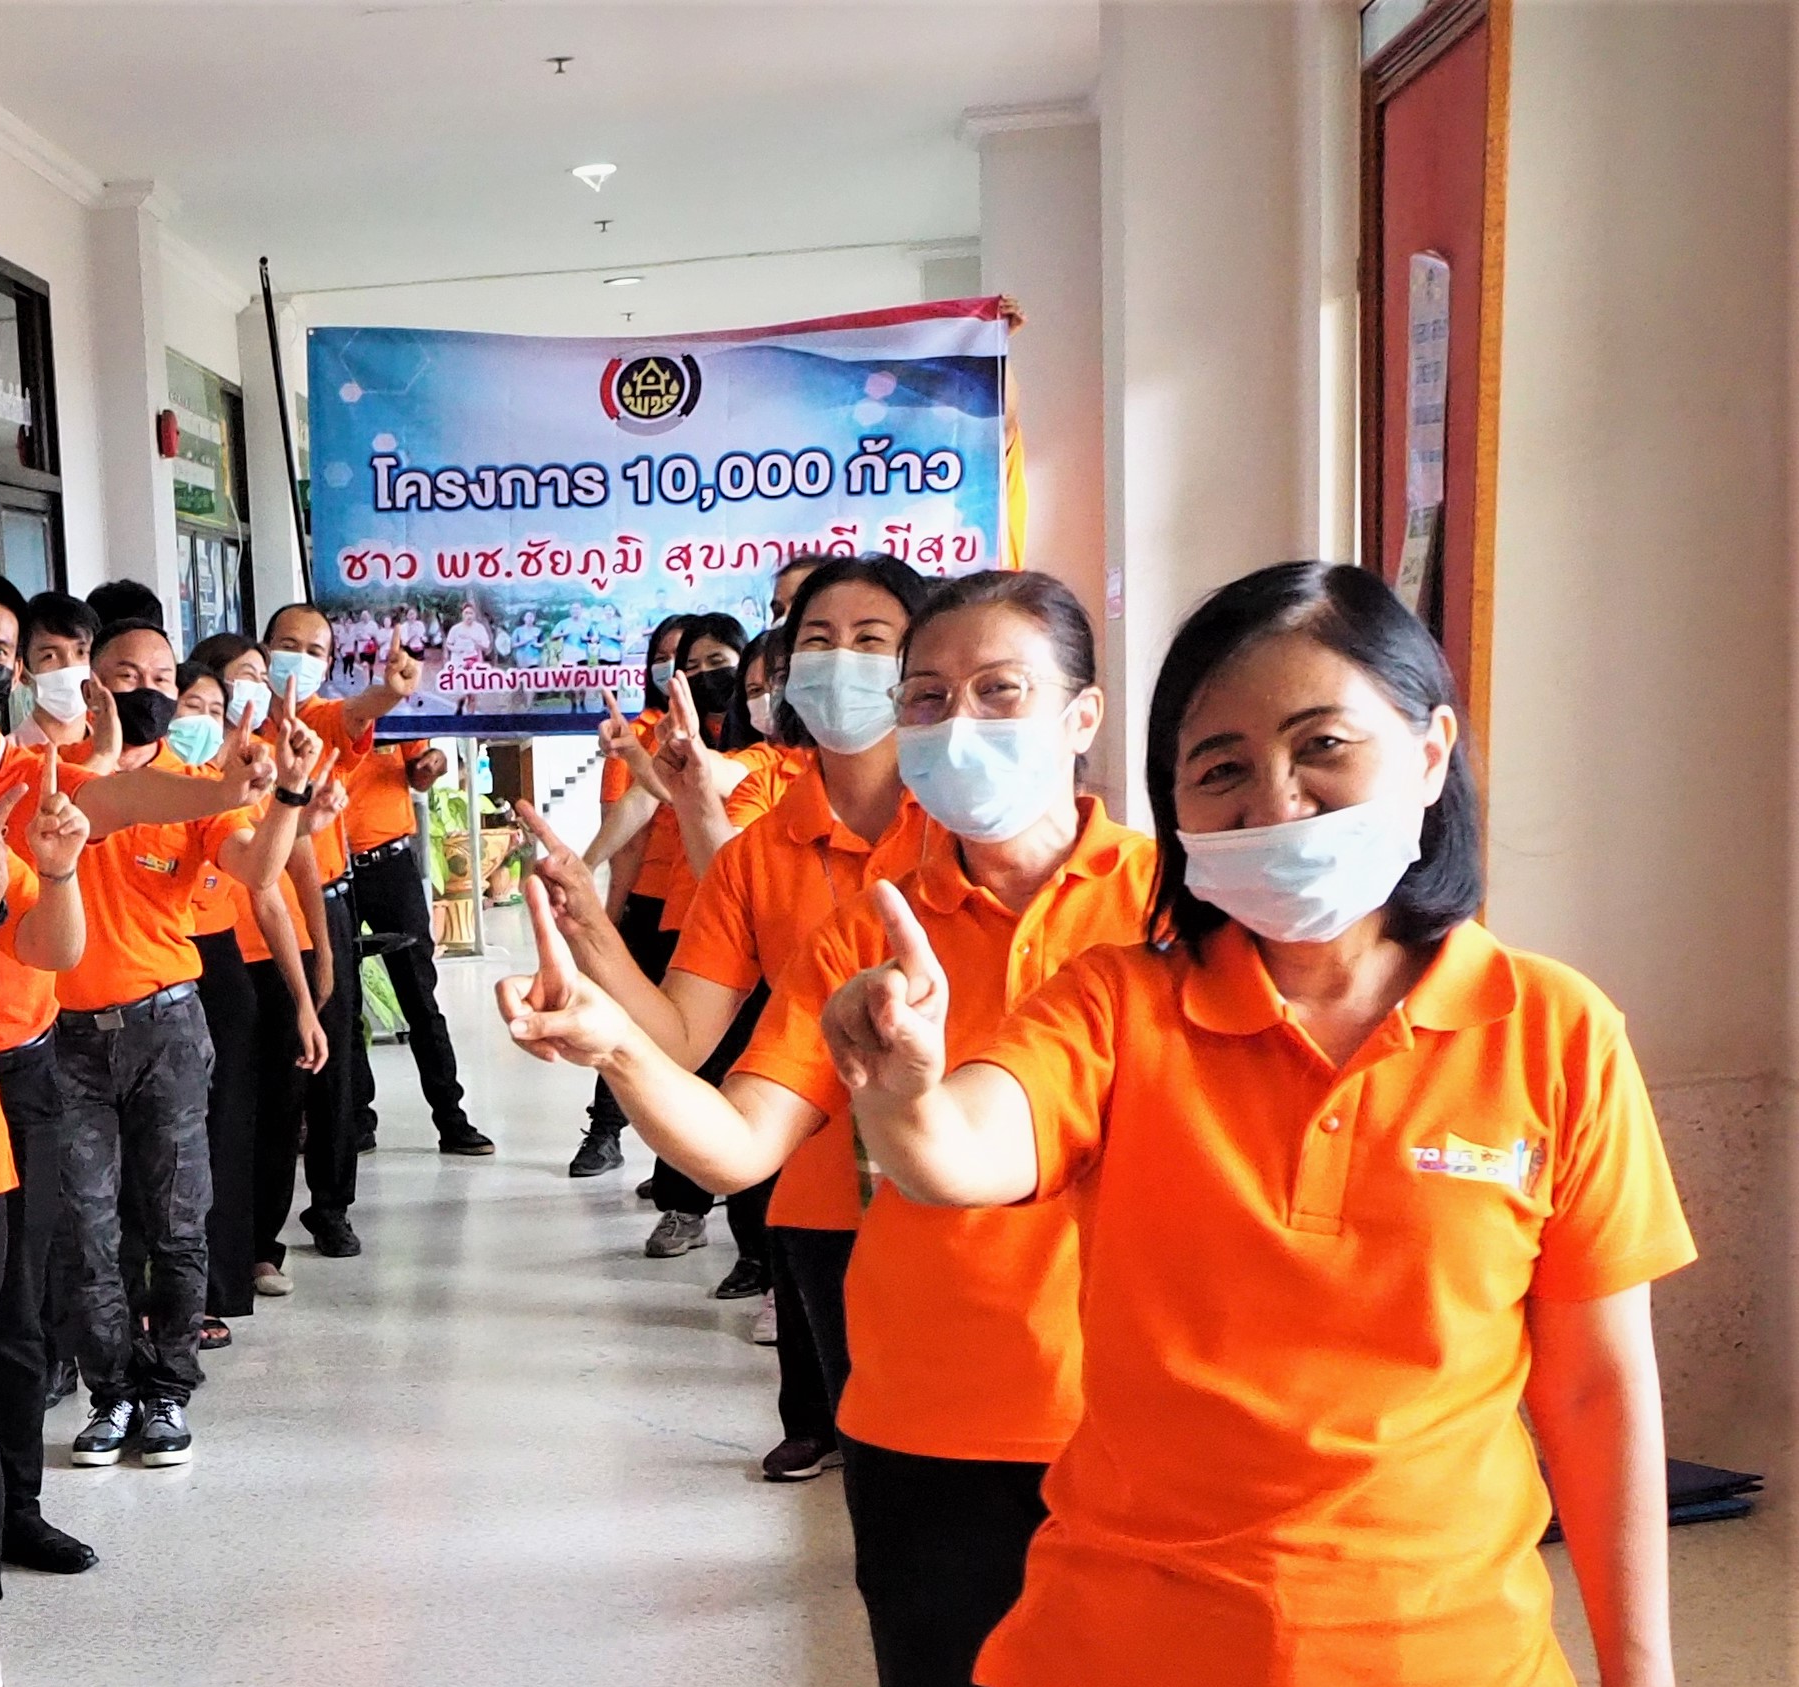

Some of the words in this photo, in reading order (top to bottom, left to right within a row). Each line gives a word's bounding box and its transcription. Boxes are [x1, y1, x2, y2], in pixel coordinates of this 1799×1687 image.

[371, 453, 606, 512] โครงการ
[623, 447, 831, 512] 10,000
[844, 435, 964, 496] ก้าว
[342, 547, 418, 582] ชาว
[437, 534, 645, 590] พช.ชัยภูมิ
[439, 662, 647, 692] สำนักงานพัฒนาช
[1409, 1146, 1441, 1162] TO
